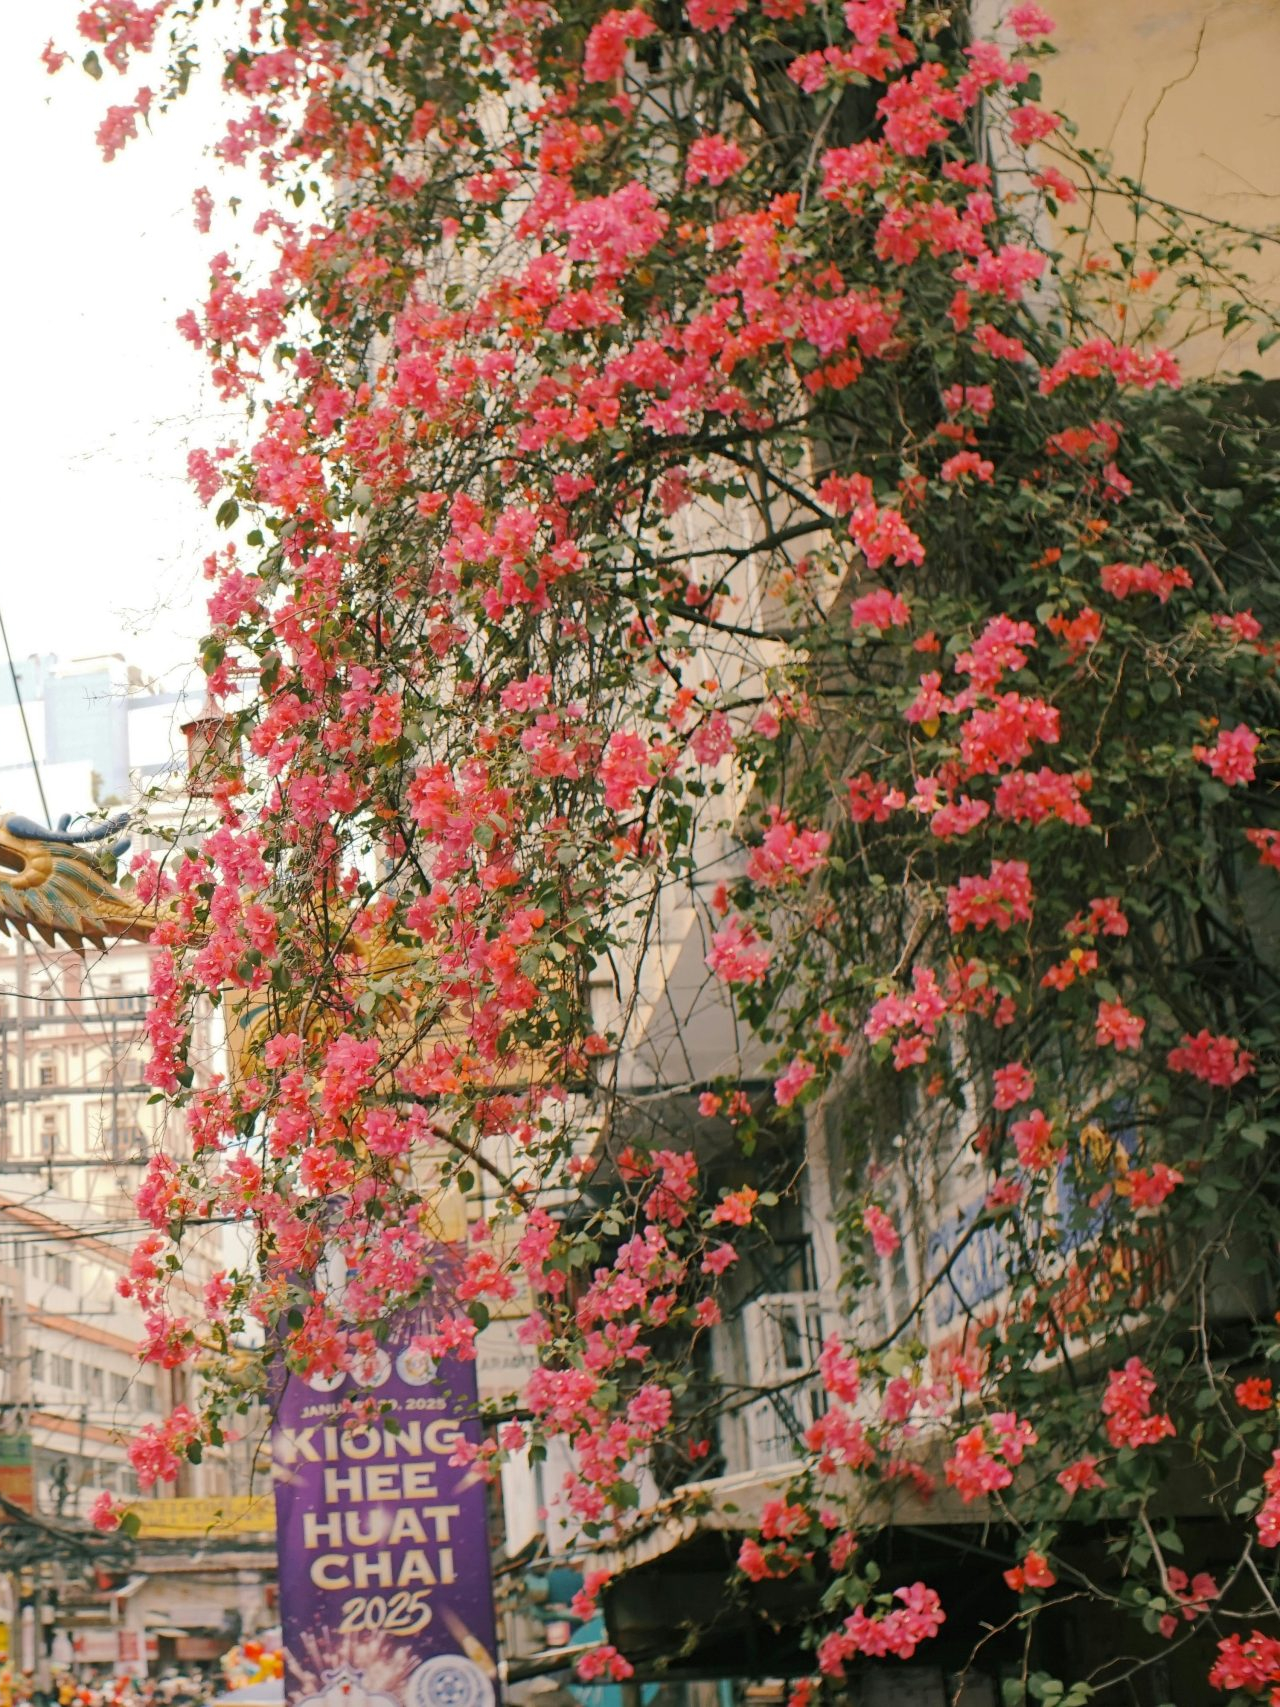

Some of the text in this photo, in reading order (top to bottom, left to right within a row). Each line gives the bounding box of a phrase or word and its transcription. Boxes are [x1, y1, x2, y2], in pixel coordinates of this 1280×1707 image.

[281, 1418, 466, 1464] KIONG
[323, 1461, 438, 1505] HEE
[303, 1504, 460, 1549] HUAT
[309, 1548, 456, 1591] CHAI
[337, 1589, 433, 1636] 2025
